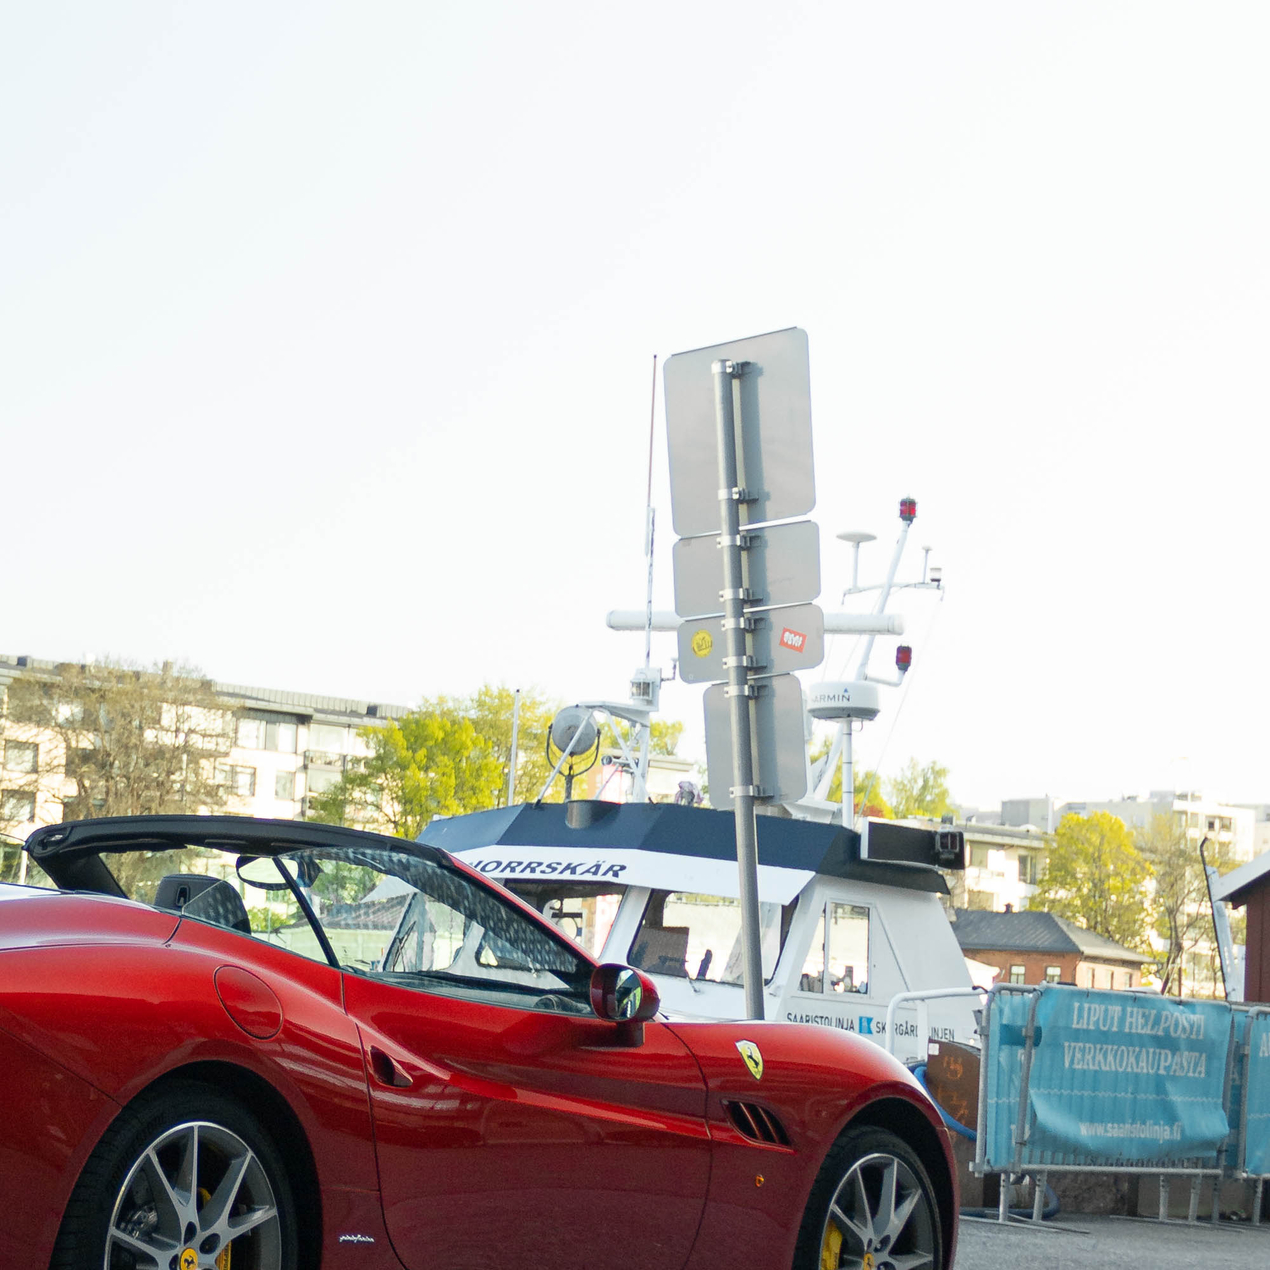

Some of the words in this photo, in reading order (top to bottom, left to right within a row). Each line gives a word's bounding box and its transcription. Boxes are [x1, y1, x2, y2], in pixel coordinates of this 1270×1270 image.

[1072, 1002, 1123, 1033] LIPUT
[1124, 1004, 1205, 1040] HELPOSTI
[1063, 1040, 1207, 1079] VERKKOKAUPASTA
[1078, 1118, 1183, 1144] www.saaristolinja.fi
